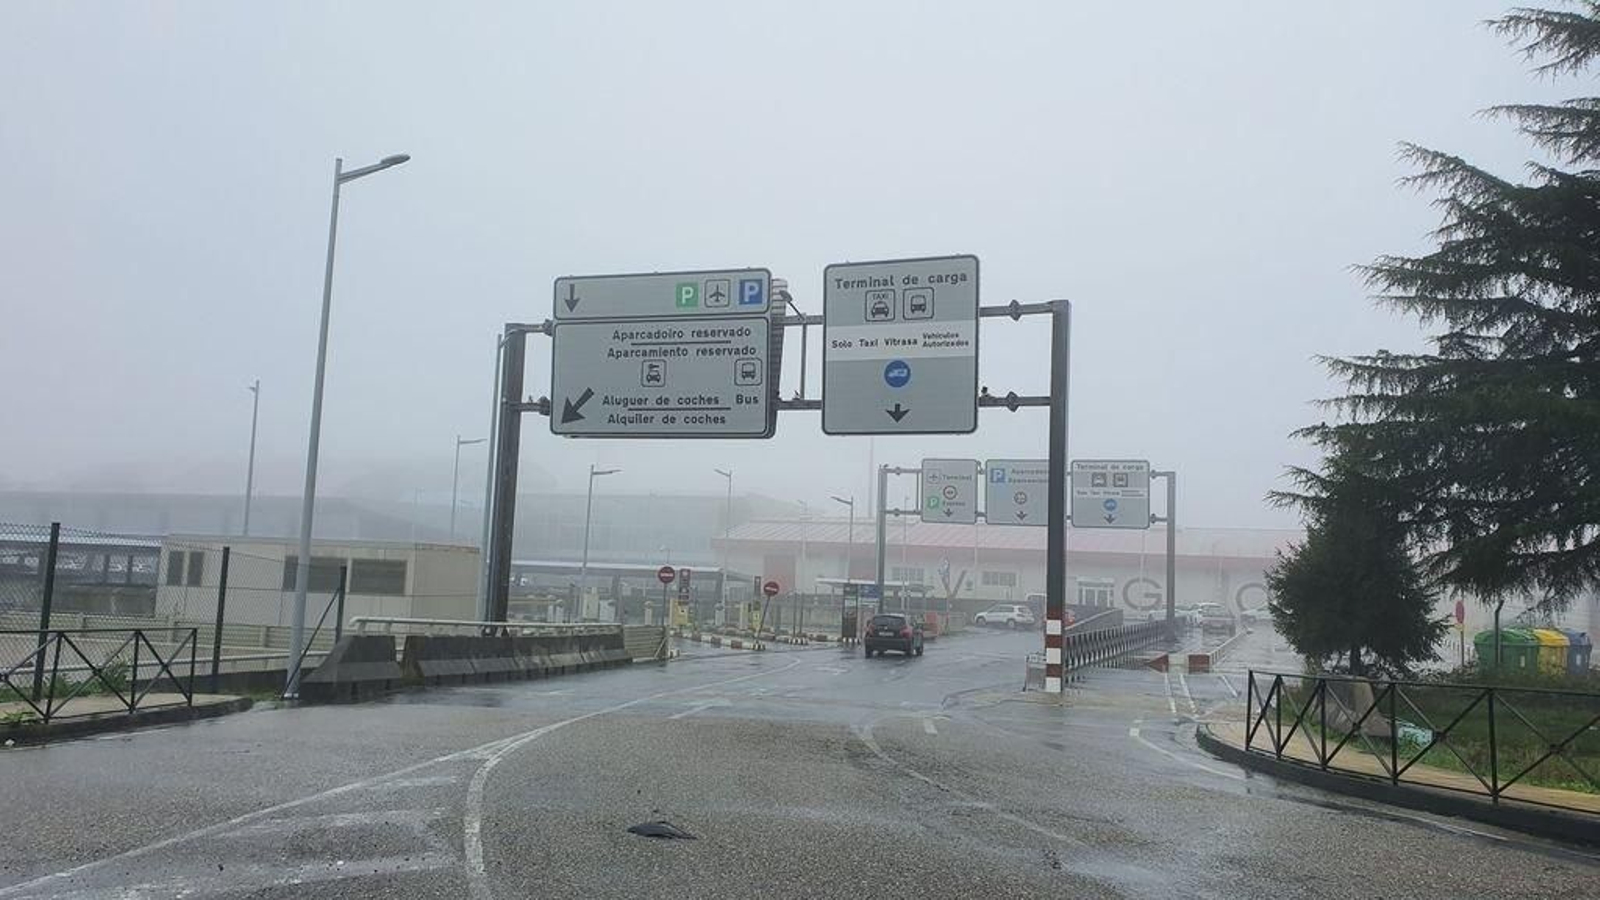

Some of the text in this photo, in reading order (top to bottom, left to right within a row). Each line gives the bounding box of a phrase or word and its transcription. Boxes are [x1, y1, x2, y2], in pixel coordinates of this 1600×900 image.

[834, 273, 967, 290] Terminal de carga
[682, 281, 759, 304] P P
[612, 326, 752, 342] Aparcadoiro reservado
[831, 338, 918, 349] Solo Taxi Vitrasa
[607, 345, 757, 359] Aparcamiento reservado
[602, 394, 719, 407] Aluguer de coches
[736, 394, 759, 404] Bus
[608, 413, 726, 426] Alquiler de coches
